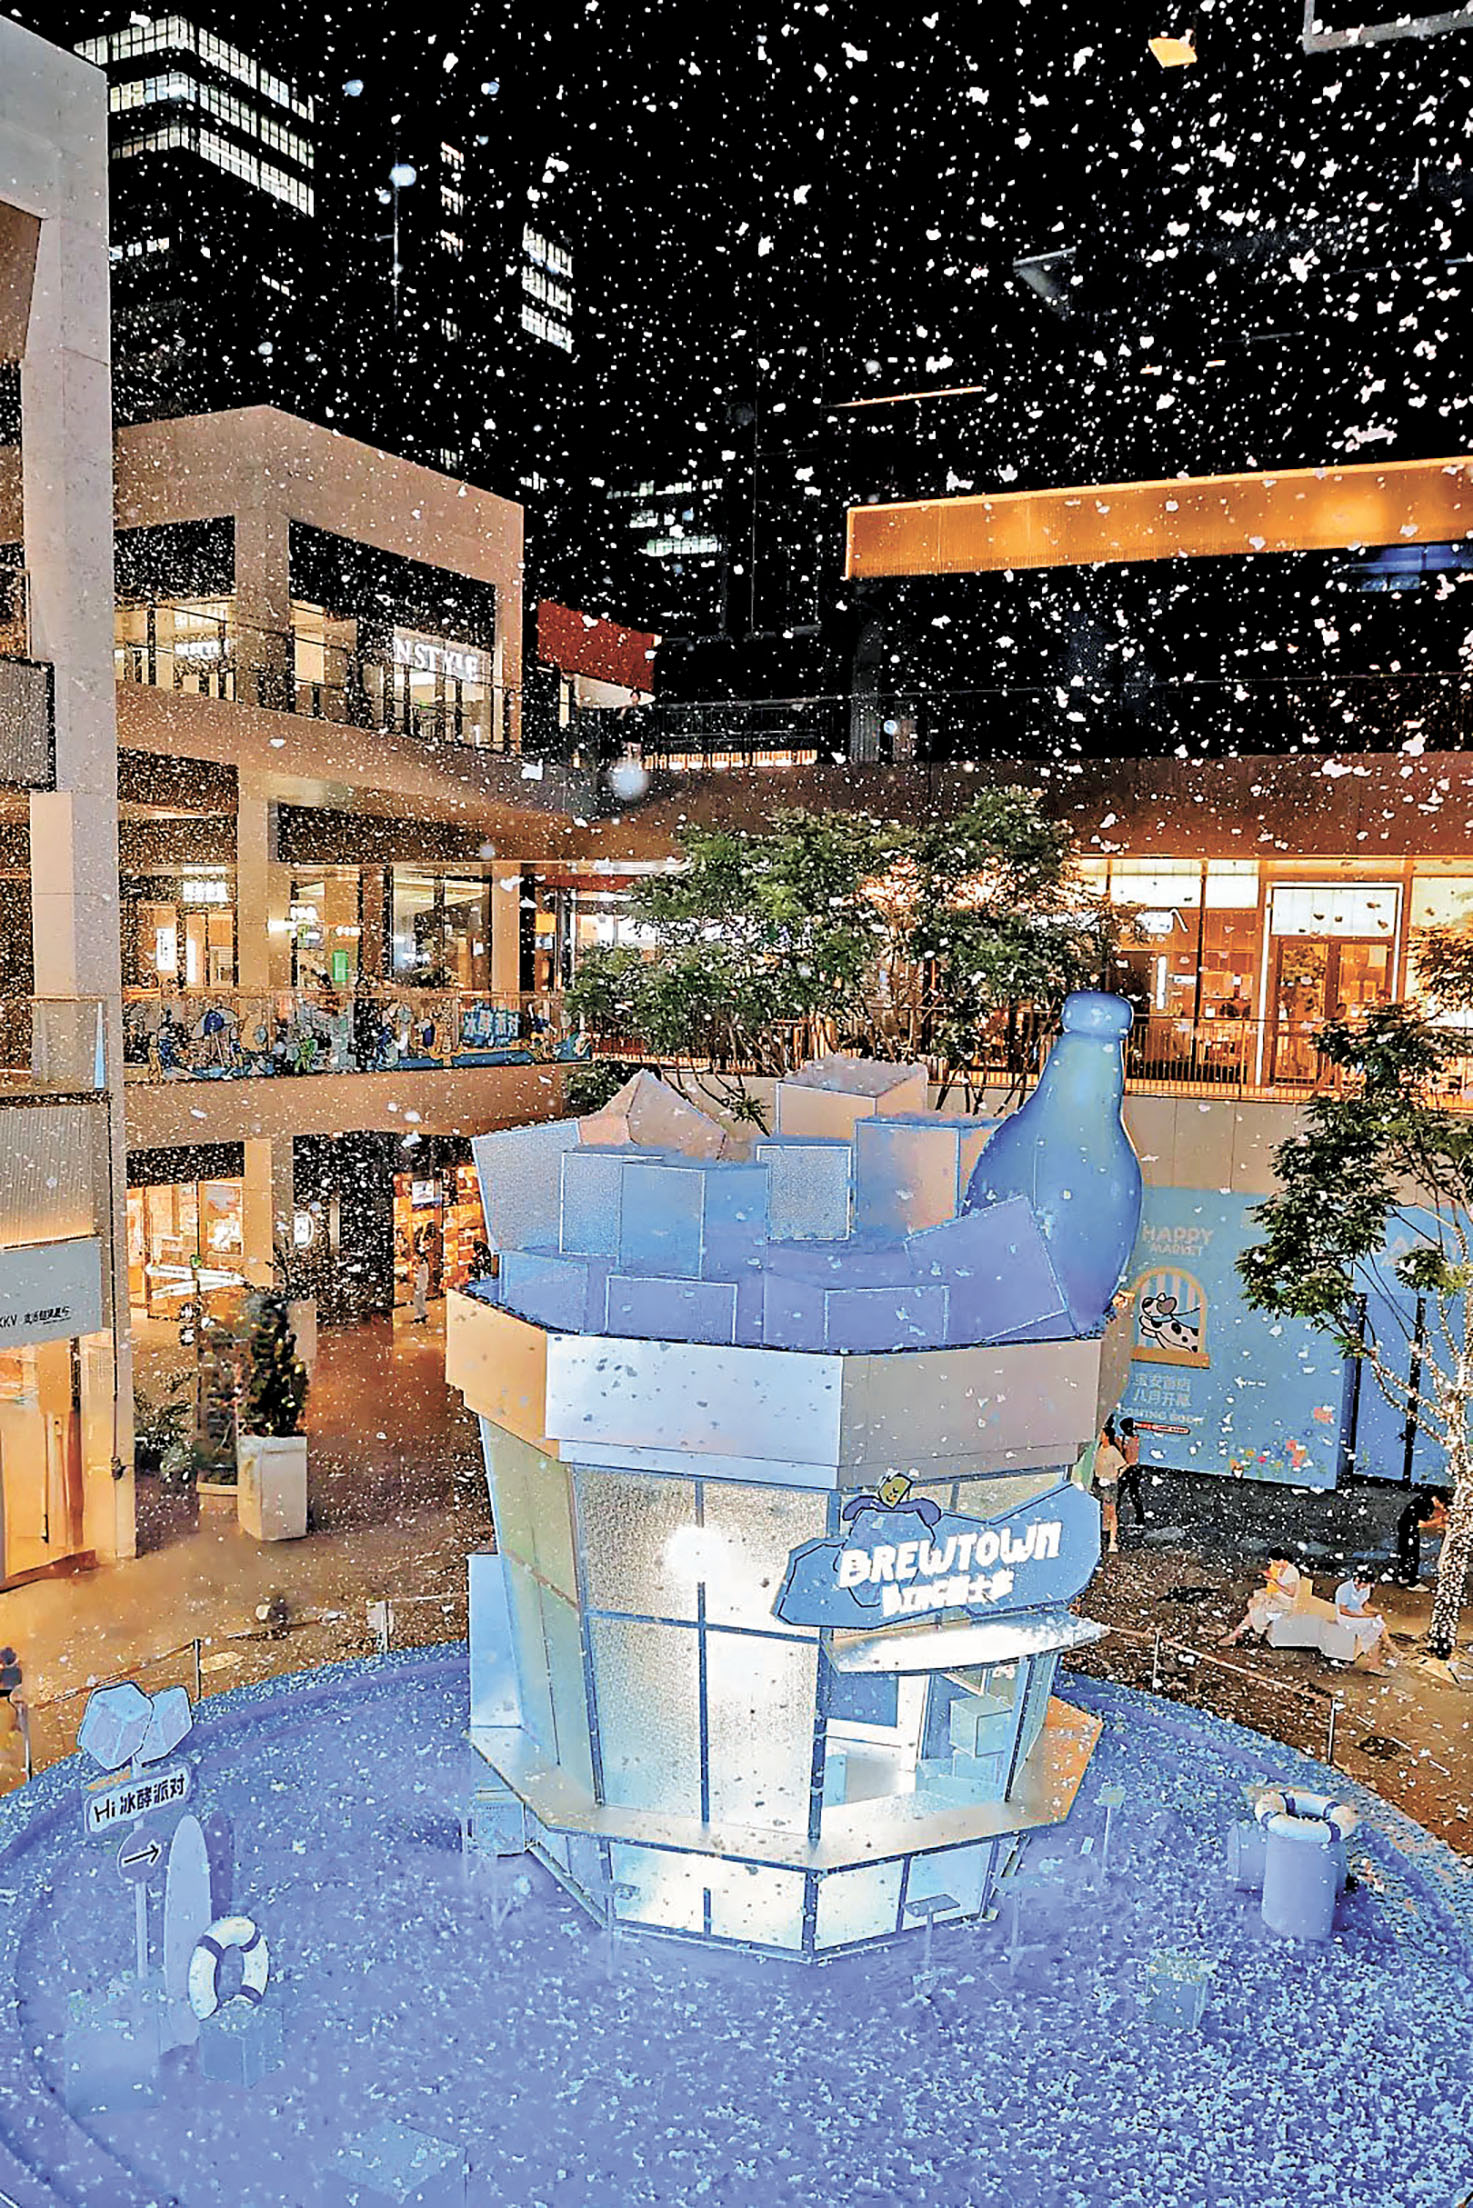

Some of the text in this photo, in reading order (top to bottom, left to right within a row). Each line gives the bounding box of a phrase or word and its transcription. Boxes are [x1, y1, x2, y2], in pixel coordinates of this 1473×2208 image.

[1142, 1225, 1214, 1245] HAPPY
[1151, 1242, 1203, 1256] MARKET
[1117, 1406, 1168, 1420] COMING
[839, 1521, 1062, 1588] BREWTOWN
[94, 1773, 185, 1822] Hi 冰酵派对
